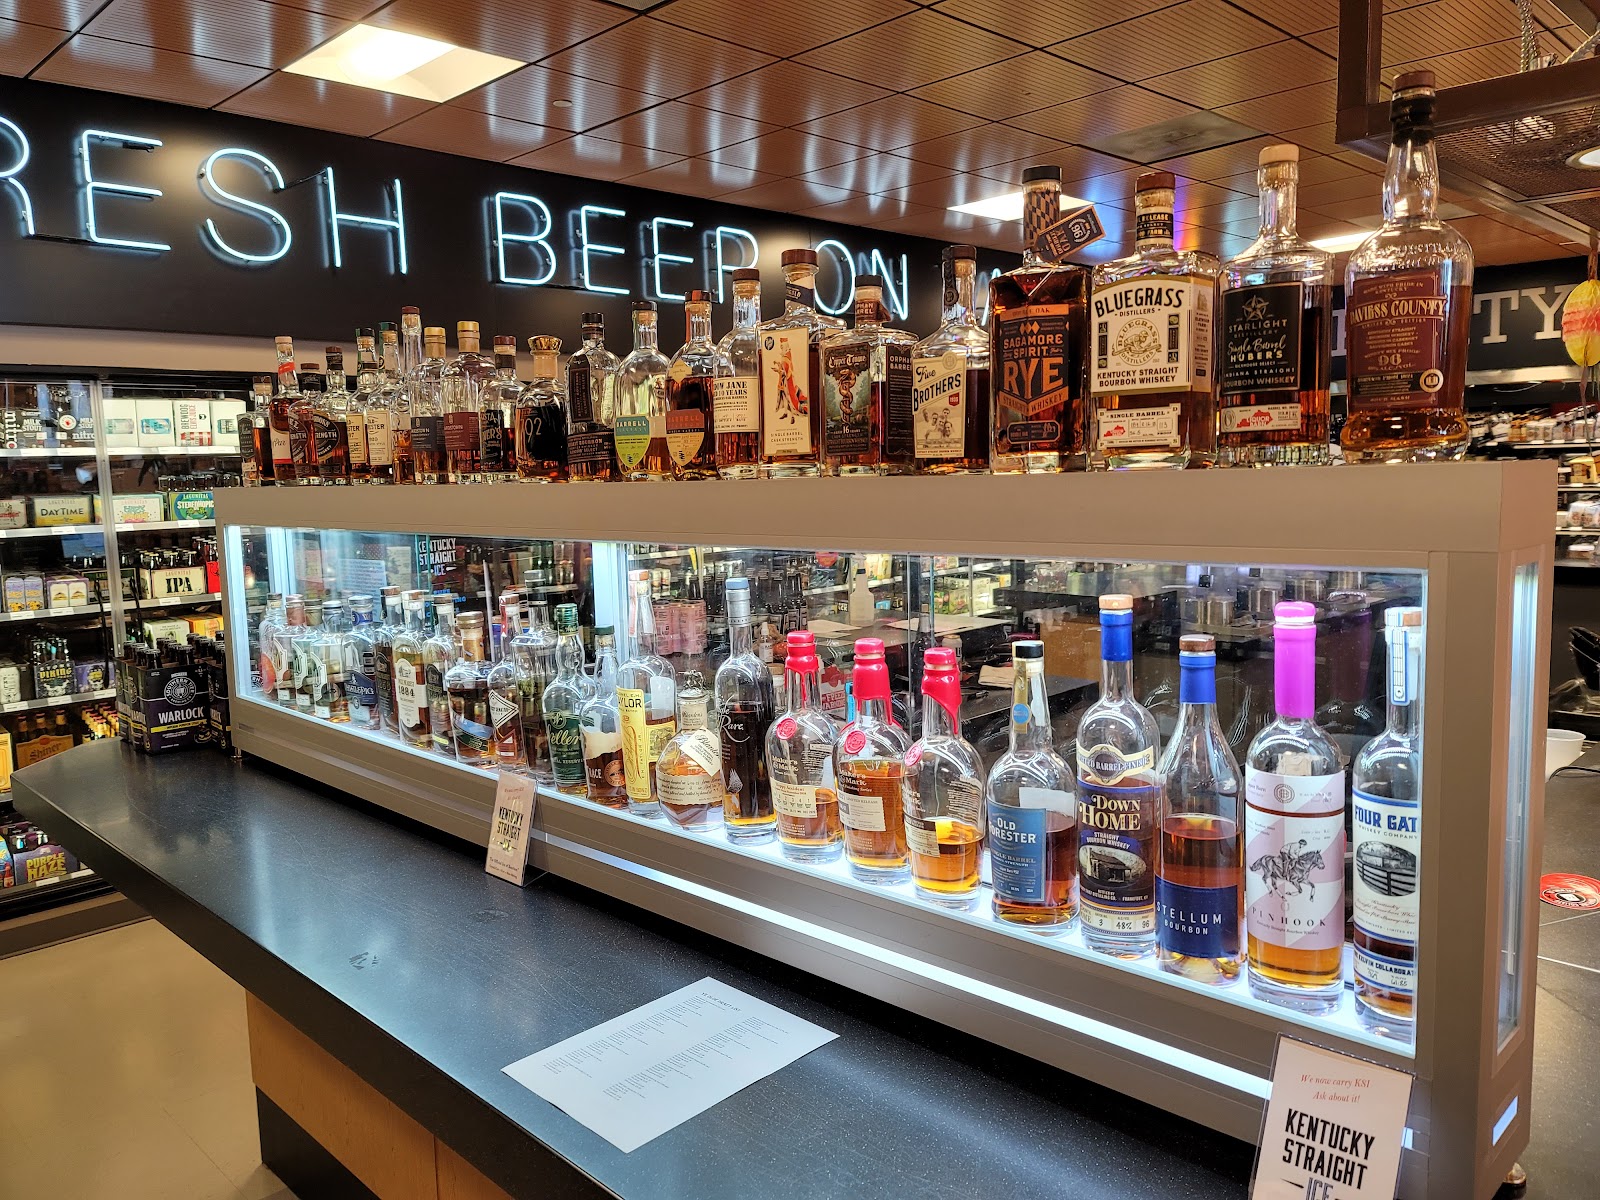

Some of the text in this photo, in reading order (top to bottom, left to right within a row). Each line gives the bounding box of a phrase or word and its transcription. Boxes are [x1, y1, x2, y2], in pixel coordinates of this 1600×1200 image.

[813, 239, 908, 321] ON
[1035, 306, 1050, 314] OAK
[1094, 287, 1185, 318] BLUEGRASS
[1390, 299, 1446, 317] COUNTY
[1119, 307, 1155, 317] DISTILLERS
[1117, 319, 1159, 347] BLUEGRASS
[1228, 319, 1288, 334] STARLIGHT
[1003, 333, 1064, 350] SAGAMORE
[1227, 334, 1287, 356] Single Barrel
[1121, 350, 1154, 365] DISTILLERS
[1230, 349, 1283, 363] HUBER'S
[915, 365, 937, 383] Five
[1003, 357, 1064, 400] RYE
[1097, 366, 1179, 380] KENTUCKY STRAIGHT
[1254, 366, 1296, 376] STRAIGHT
[725, 381, 748, 389] JANE
[1099, 374, 1176, 387] BOURBON WHISKEY
[1224, 375, 1296, 388] BOURBON WHISKEY
[912, 373, 962, 412] BROTHERS
[1031, 393, 1063, 411] WHISKEY
[1246, 415, 1270, 423] LIQUOR
[843, 425, 850, 434] 16
[40, 507, 84, 517] DAYTIME
[419, 550, 456, 566] STRAIGHT
[434, 564, 446, 576] ICE
[165, 577, 193, 593] IPA
[158, 706, 205, 724] WARLOCK
[719, 717, 745, 743] Rare
[778, 763, 799, 772] Mark
[1095, 760, 1122, 771] BARREL
[845, 776, 867, 787] Mark
[1091, 794, 1142, 812] DOWN
[499, 806, 525, 827] KENTUCKY
[997, 817, 1016, 831] OLD
[1079, 801, 1142, 831] HOME
[1354, 804, 1382, 829] FOUR
[496, 821, 522, 841] STRAIGHT
[988, 820, 1038, 844] FORESTER
[1093, 831, 1120, 841] STRAIGHT
[1358, 824, 1419, 840] WHISKEY COMPANY
[1107, 840, 1131, 850] WHISKEY
[26, 852, 65, 868] PURPLE
[1007, 854, 1037, 864] BARREL
[27, 860, 66, 882] HAZE
[1156, 901, 1222, 925] STELLUM
[1251, 905, 1327, 928] PINHOOK
[1115, 921, 1133, 931] 48%
[1164, 918, 1208, 935] BOURBON
[1358, 955, 1374, 967] KELVIN
[1300, 1074, 1314, 1083] We
[1332, 1080, 1353, 1088] carry
[1353, 1078, 1371, 1088] KSI
[1312, 1091, 1361, 1104] Ask about it!
[1284, 1107, 1376, 1161] KENTUCKY
[1282, 1137, 1368, 1190] STRAIGHT
[1304, 1176, 1334, 1200] ICE
